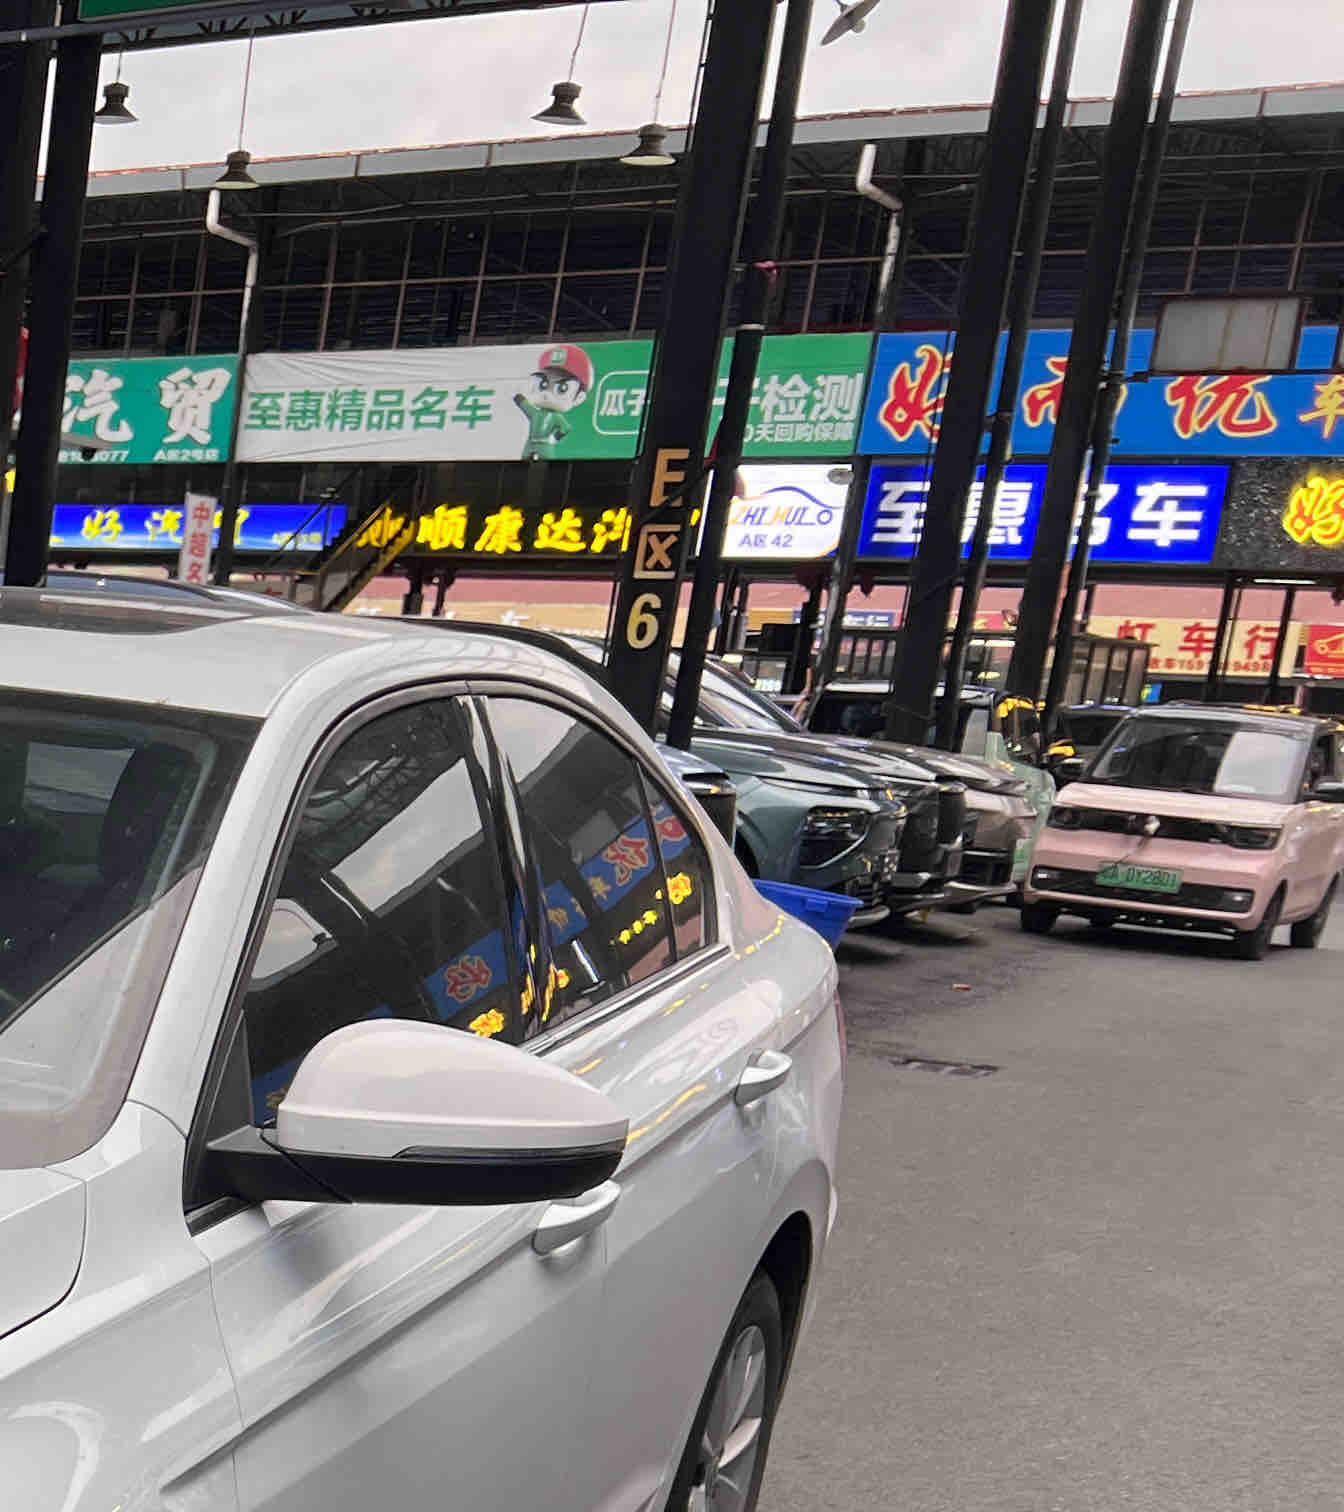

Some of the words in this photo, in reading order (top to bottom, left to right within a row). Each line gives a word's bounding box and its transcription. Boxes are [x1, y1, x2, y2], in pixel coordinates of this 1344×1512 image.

[244, 386, 496, 432] 至惠精品名车
